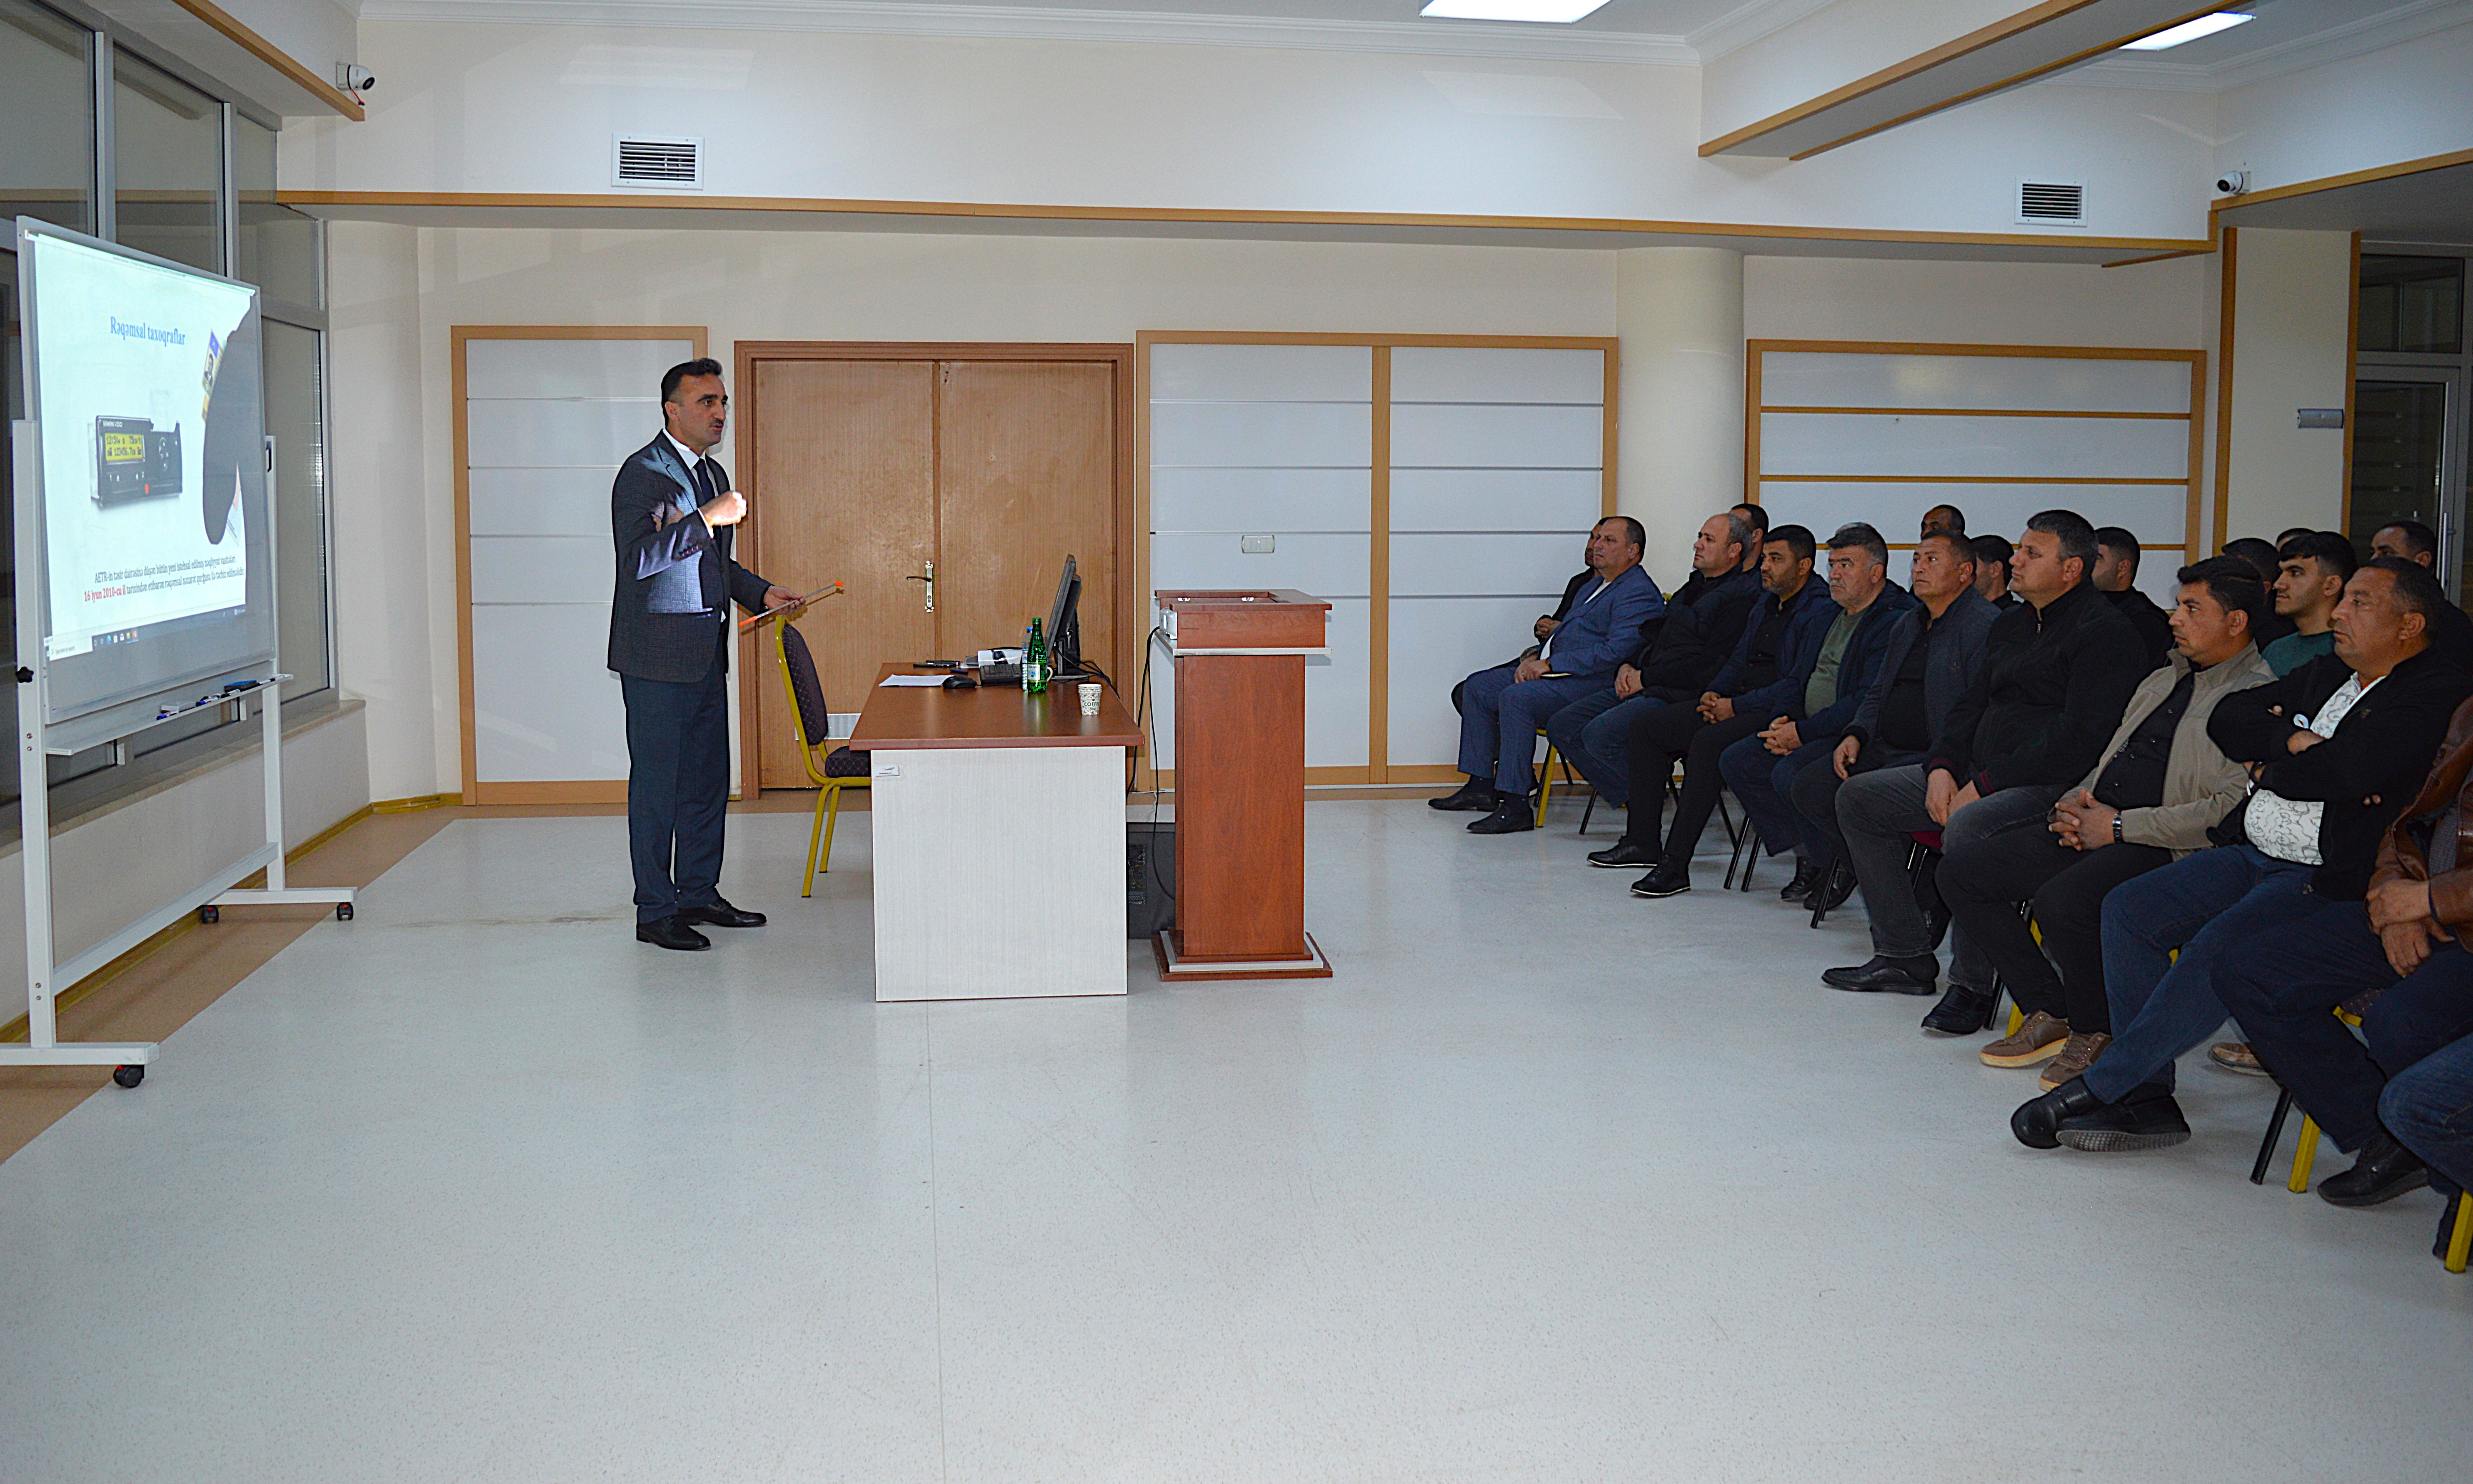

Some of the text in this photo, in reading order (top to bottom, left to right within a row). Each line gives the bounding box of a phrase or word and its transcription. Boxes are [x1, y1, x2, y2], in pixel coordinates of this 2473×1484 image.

[110, 316, 185, 347] Rəqəmsal taxoqraflar
[85, 591, 90, 602] 16
[91, 590, 102, 603] iyun
